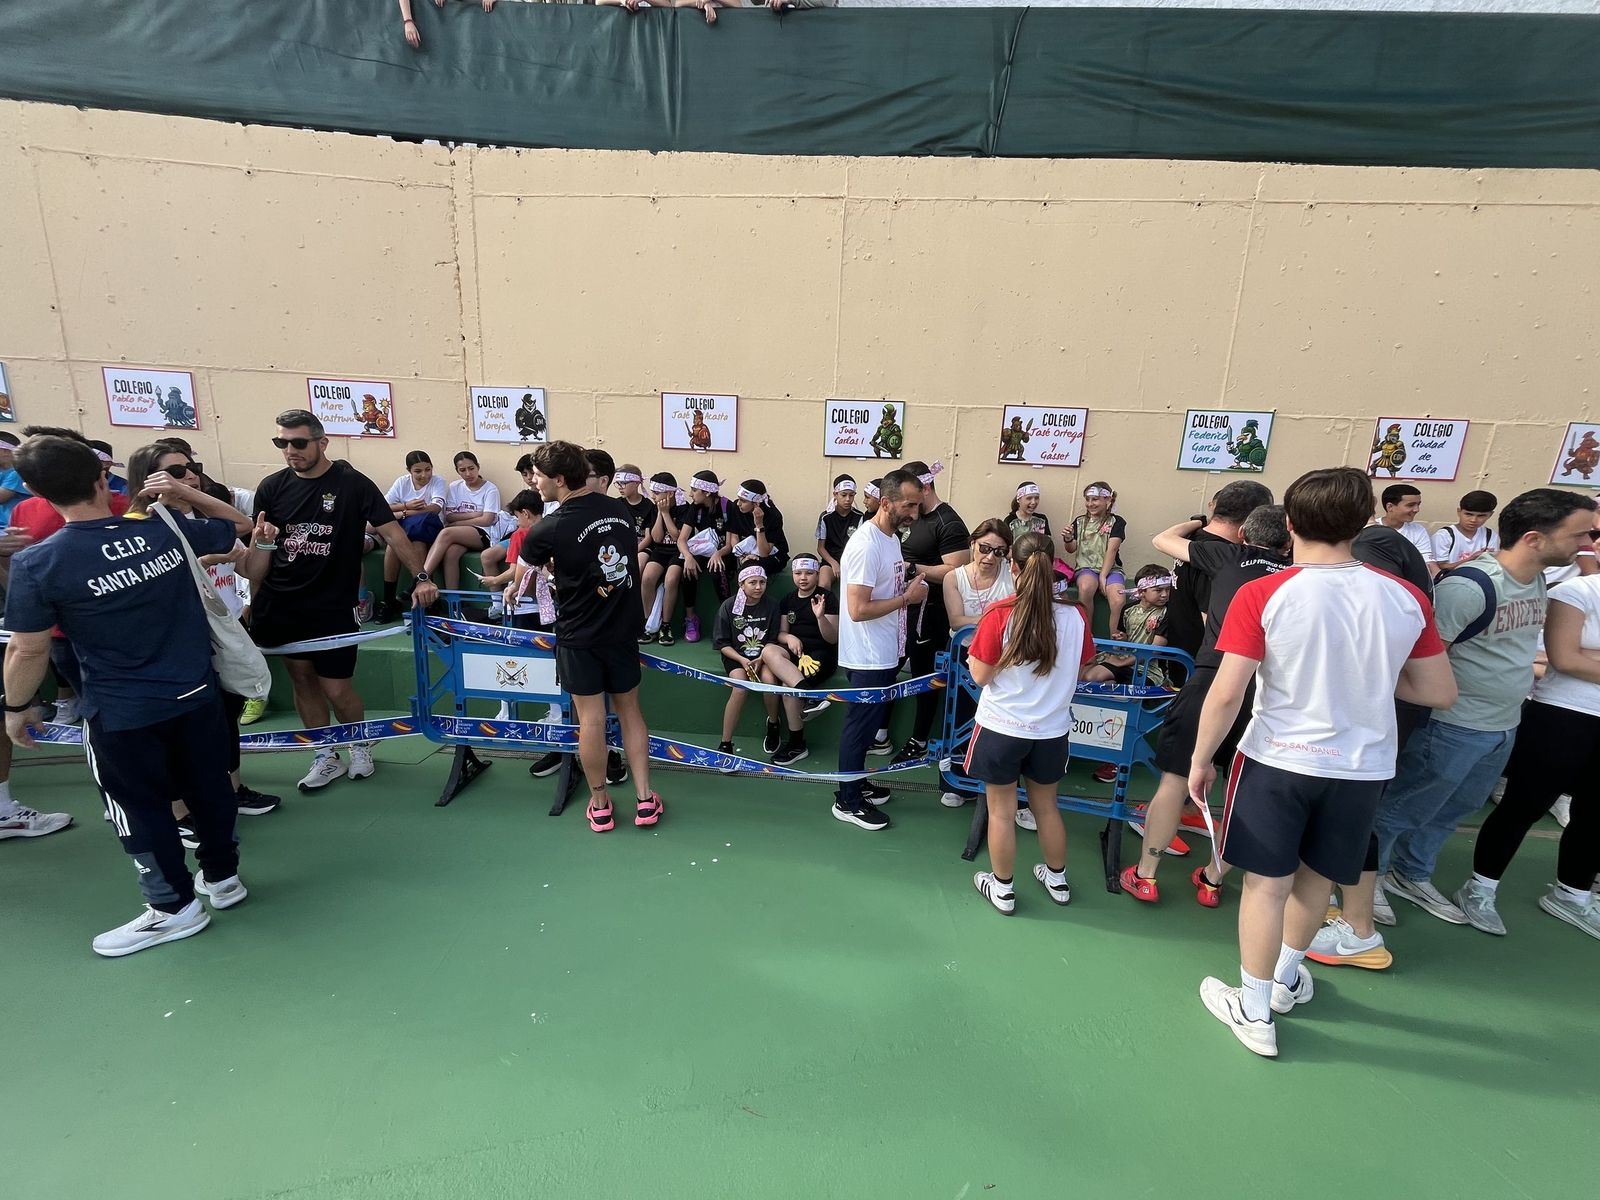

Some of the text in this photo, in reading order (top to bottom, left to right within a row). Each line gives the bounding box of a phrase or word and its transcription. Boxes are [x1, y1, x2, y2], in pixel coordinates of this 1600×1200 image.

[114, 379, 152, 394] COLEGIO
[314, 385, 351, 400] COLEGIO
[321, 401, 344, 410] Mare
[478, 395, 509, 408] COLEGIO
[685, 398, 714, 410] COLEGIO
[120, 405, 148, 413] Picasso
[484, 410, 505, 419] Juan
[832, 408, 869, 424] COLEGIO
[1042, 413, 1076, 427] COLEGIO
[1192, 414, 1229, 429] COLEGIO
[839, 426, 858, 434] Juan
[1030, 427, 1084, 443] José Ortega
[1189, 430, 1228, 440] Federico
[1414, 423, 1454, 438] COLEGIO
[834, 436, 859, 445] Carlos
[1411, 440, 1446, 449] Ciudad
[1051, 442, 1057, 452] y
[1192, 443, 1221, 452] García
[1041, 451, 1070, 460] Gasset
[1192, 454, 1216, 464] Lorca
[1419, 453, 1431, 461] de
[1410, 465, 1438, 474] Ceuta
[102, 536, 151, 561] C.E.I.P.
[88, 548, 184, 596] SANTA AMELIA
[1072, 720, 1093, 734] 300
[1289, 743, 1309, 751] SAN
[1311, 747, 1342, 756] DANIEL
